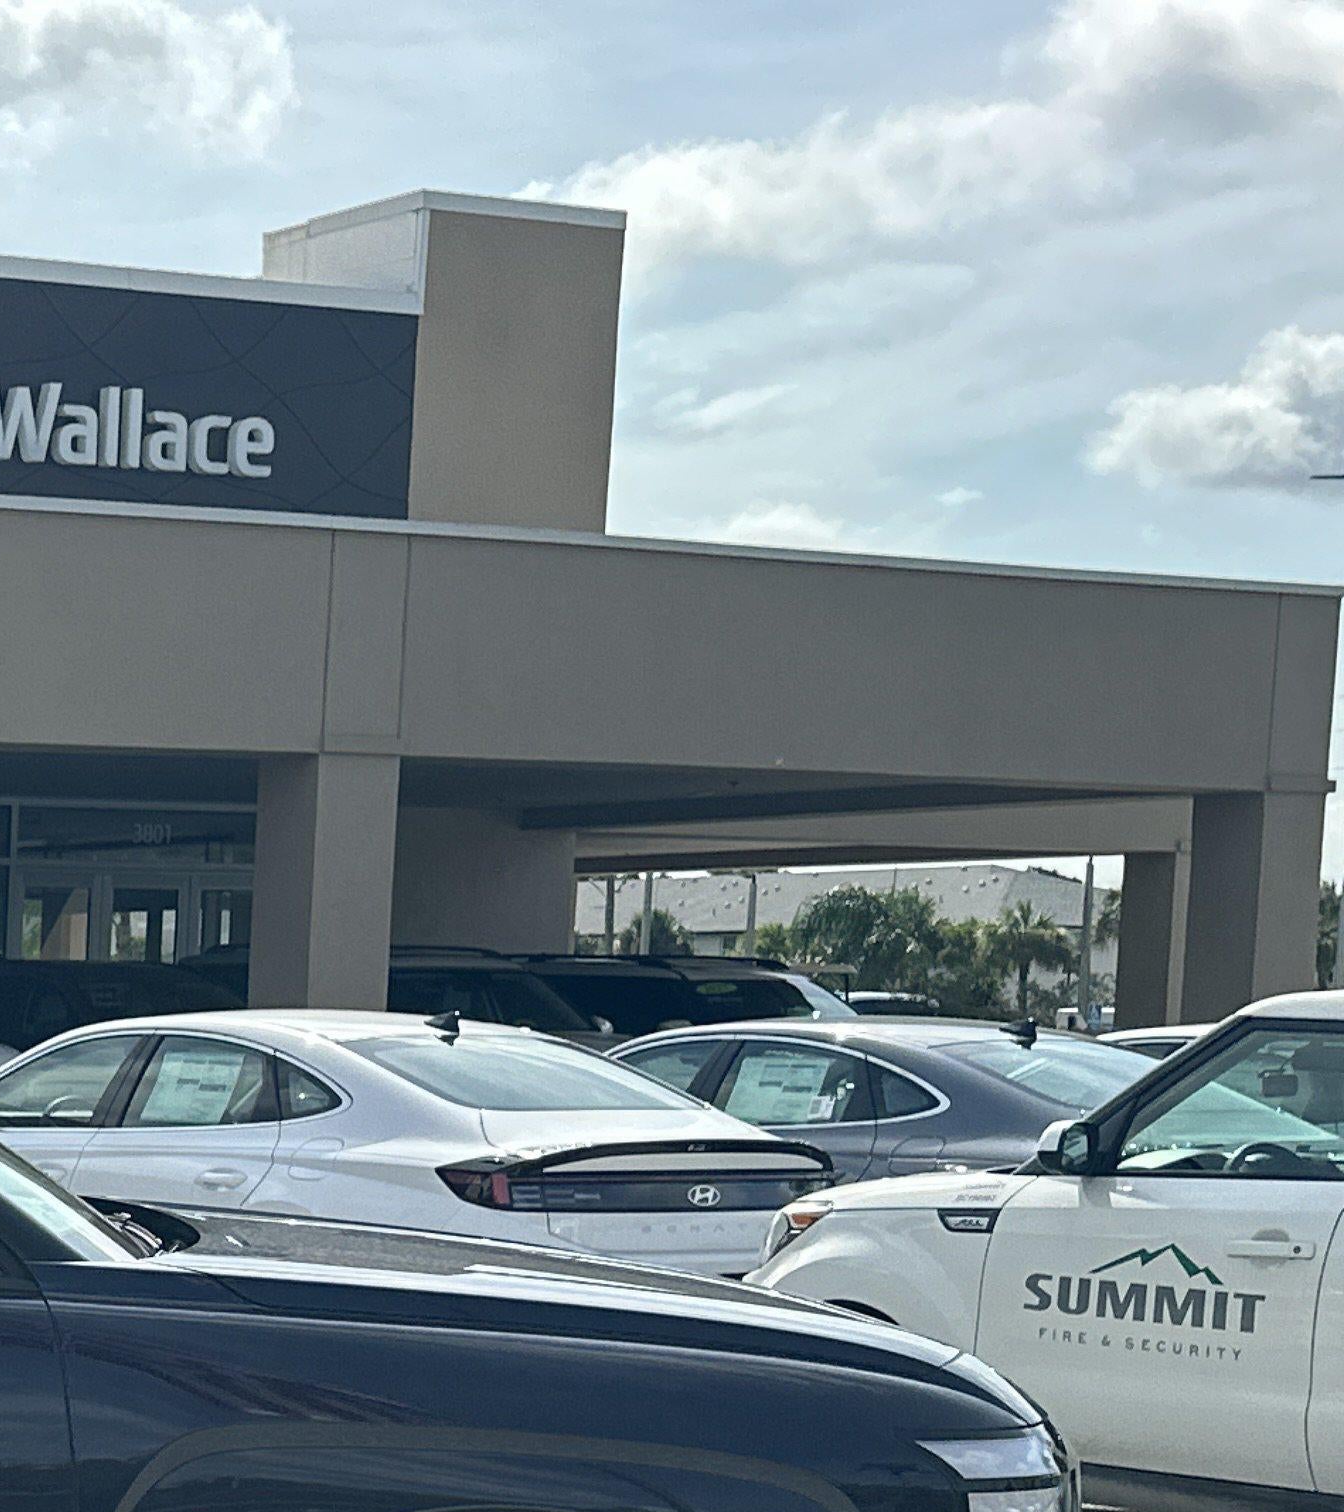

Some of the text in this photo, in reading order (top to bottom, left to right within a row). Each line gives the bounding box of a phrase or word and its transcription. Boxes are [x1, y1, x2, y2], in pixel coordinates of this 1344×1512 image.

[1023, 1272, 1266, 1334] SUMMIT
[1039, 1327, 1242, 1361] FIRE & SECURITY
